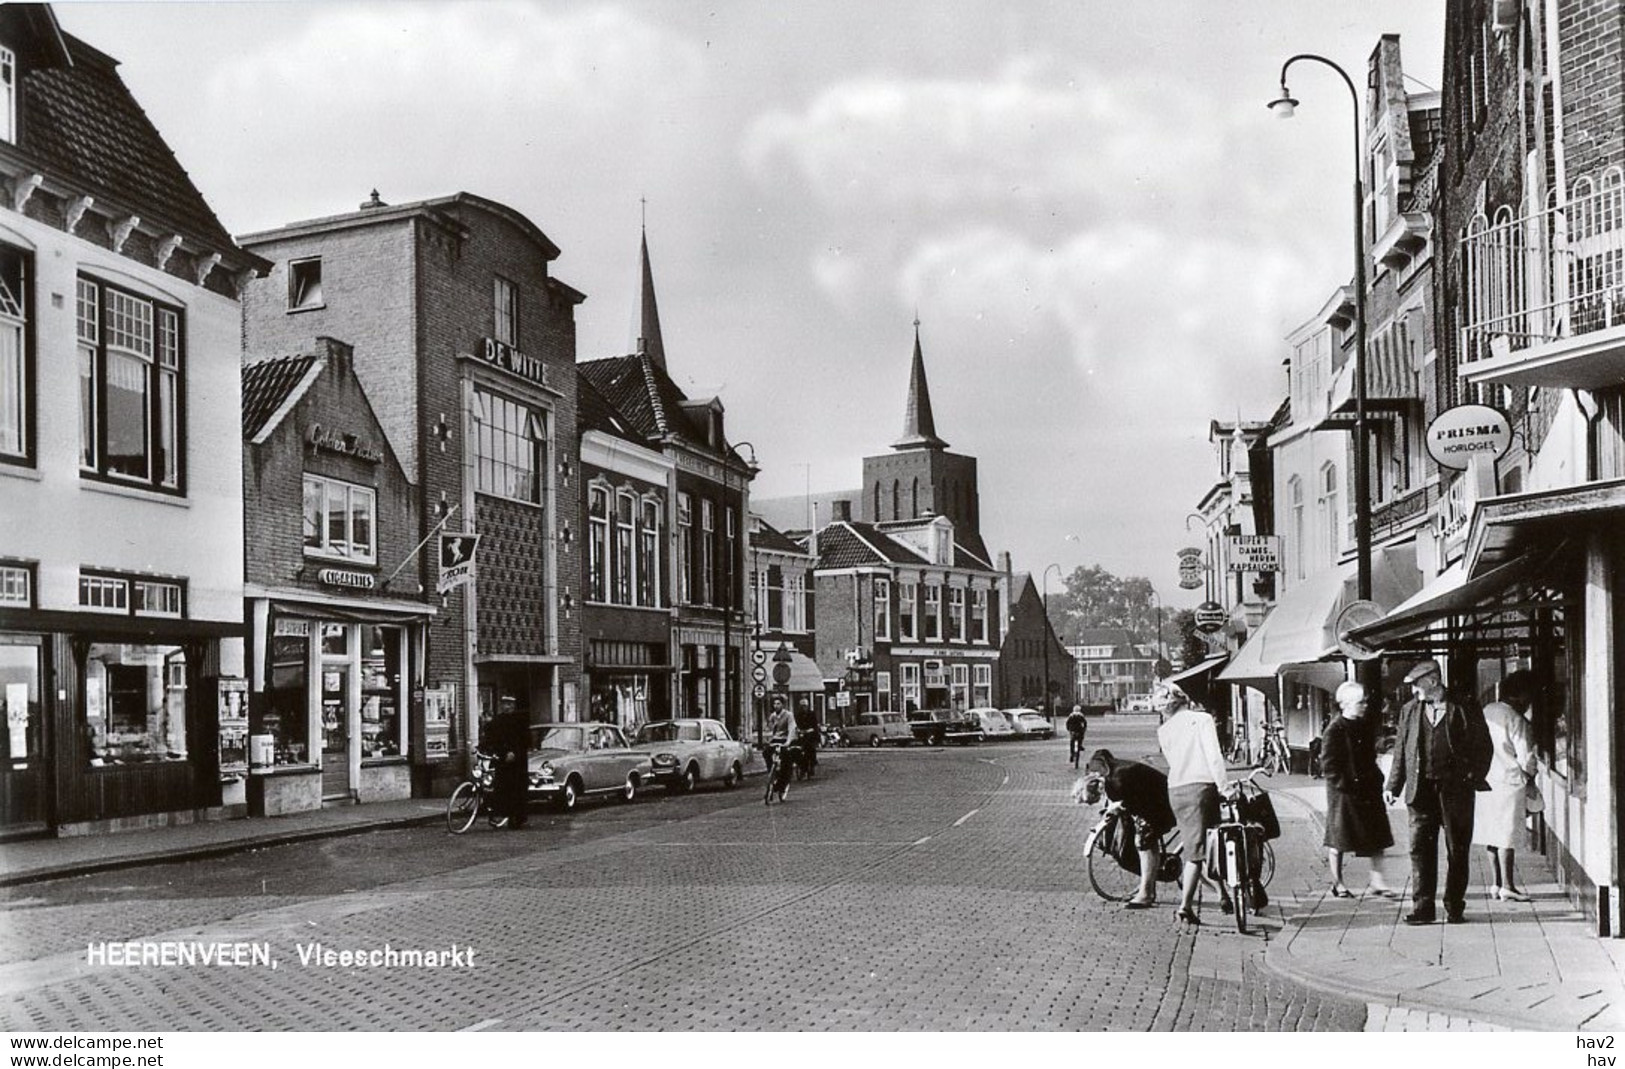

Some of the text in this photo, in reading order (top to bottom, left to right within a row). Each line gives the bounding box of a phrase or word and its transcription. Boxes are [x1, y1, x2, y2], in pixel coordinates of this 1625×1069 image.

[485, 337, 551, 385] DE WITTE
[1437, 424, 1501, 440] PRISMA
[1443, 440, 1496, 454] HORLOGES
[1249, 554, 1276, 562] HEREN
[1230, 563, 1280, 572] KAPSALONS
[839, 678, 846, 691] P
